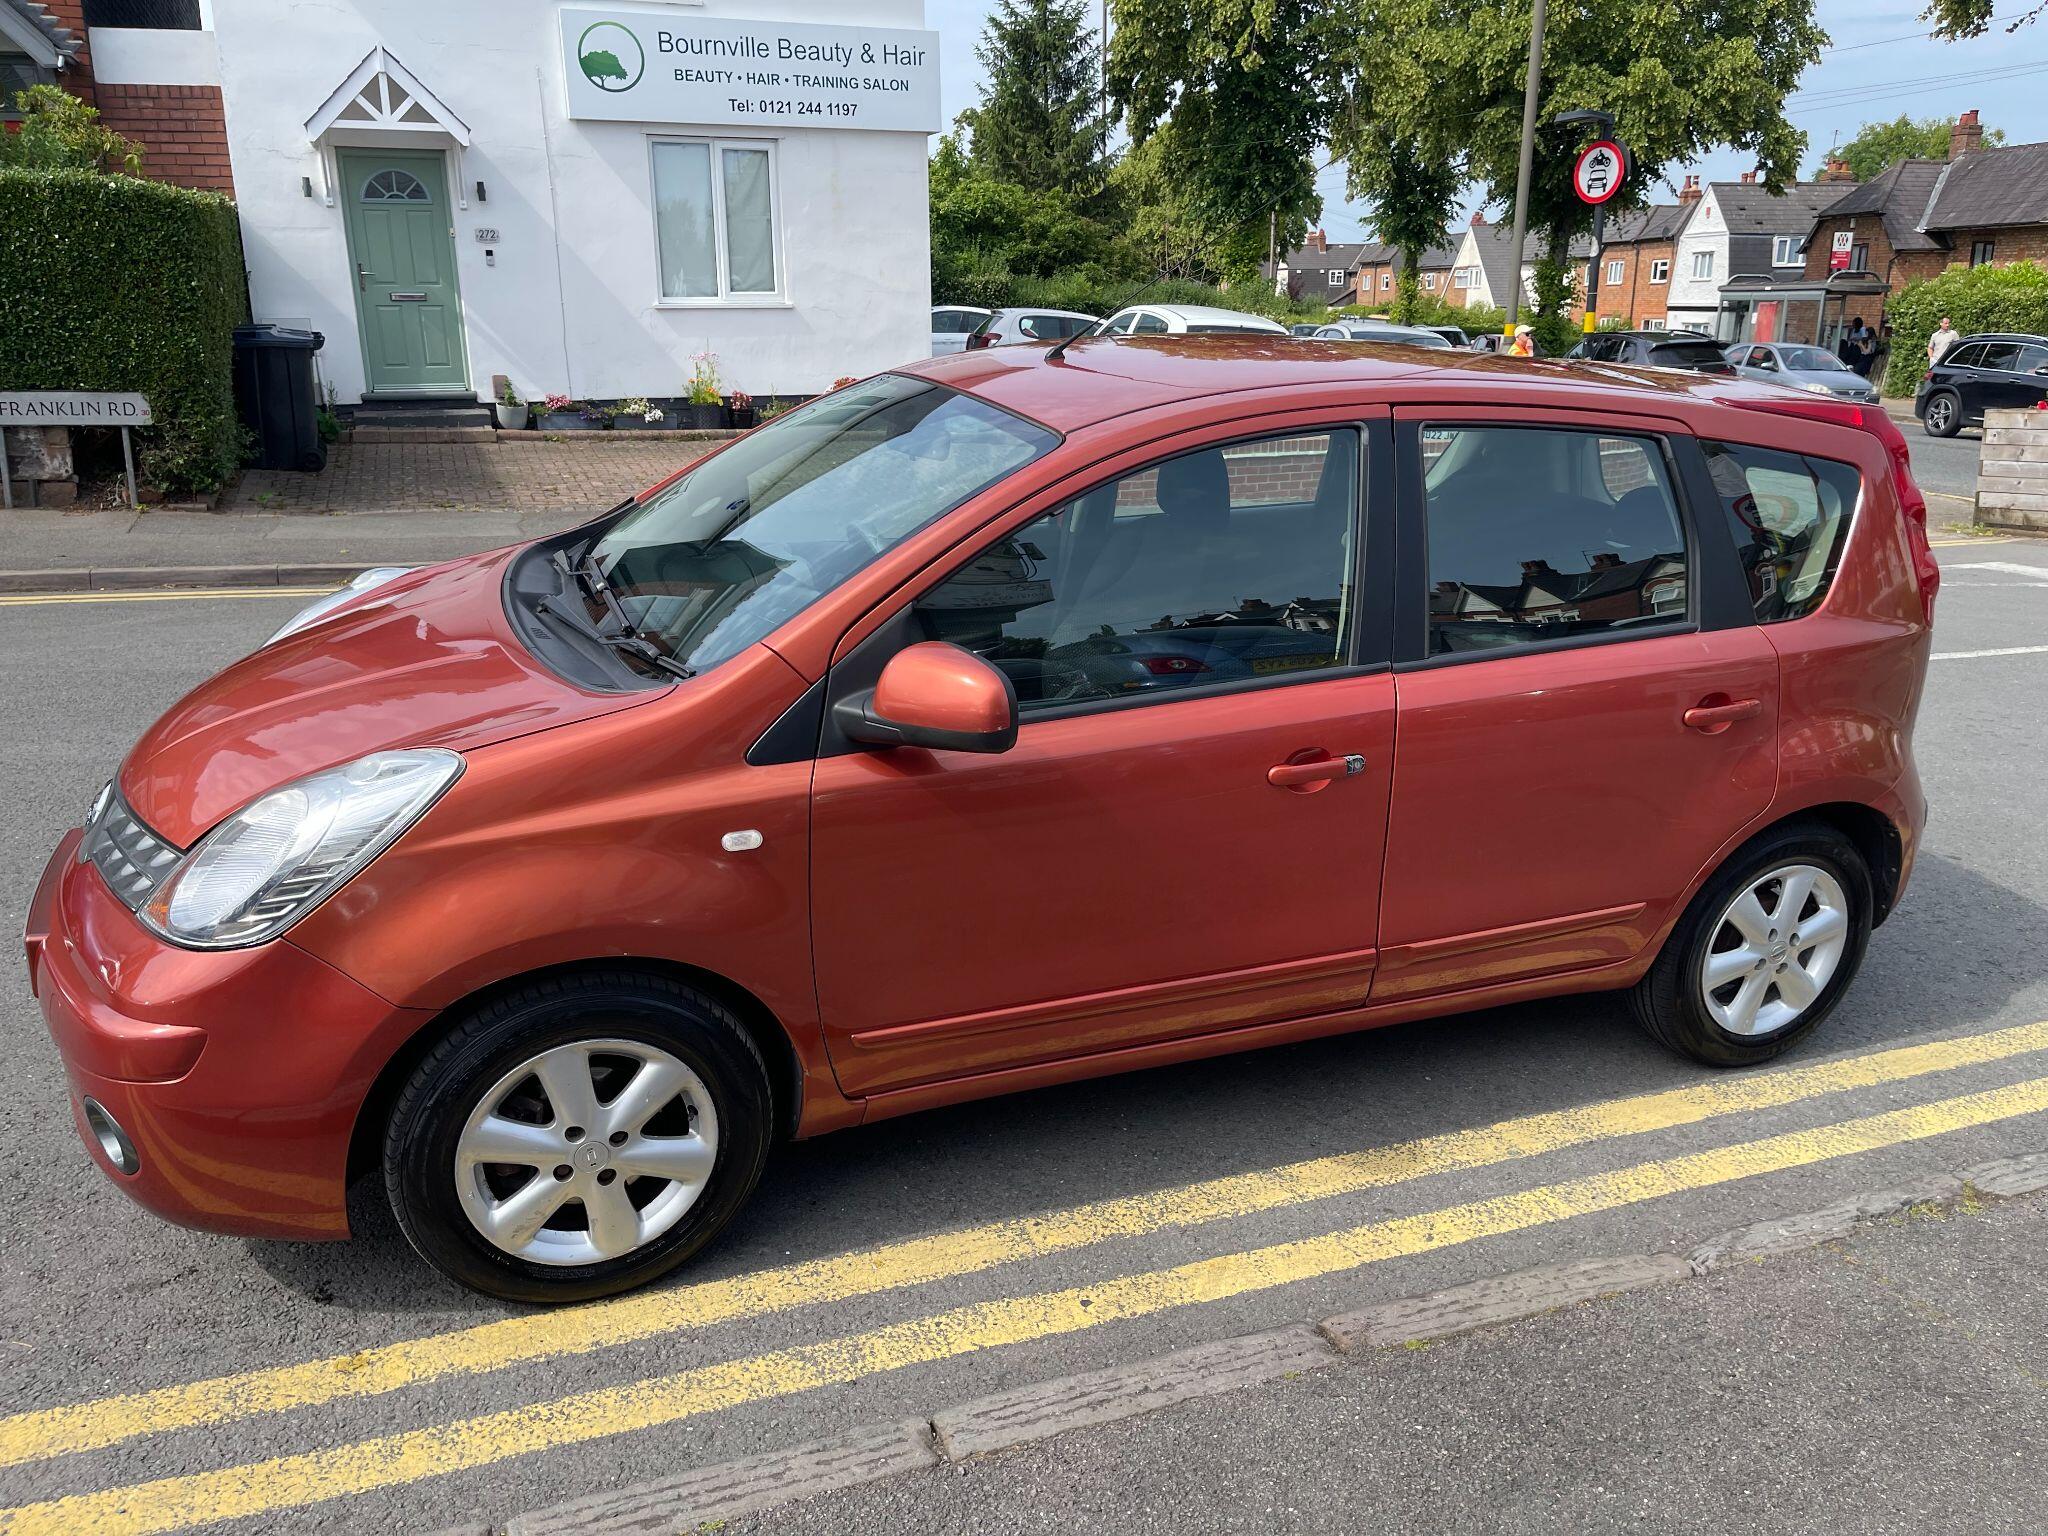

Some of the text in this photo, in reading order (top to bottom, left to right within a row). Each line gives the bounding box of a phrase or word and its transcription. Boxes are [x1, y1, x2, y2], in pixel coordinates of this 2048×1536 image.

[657, 31, 926, 68] Bournville Beauty & Hair
[674, 68, 909, 92] BEAUTY HAIR TRAINING SALON
[728, 98, 858, 117] Tel: 0121 244 1197
[478, 229, 496, 239] 272
[0, 401, 101, 417] FRANKLIN
[108, 401, 139, 417] RD.
